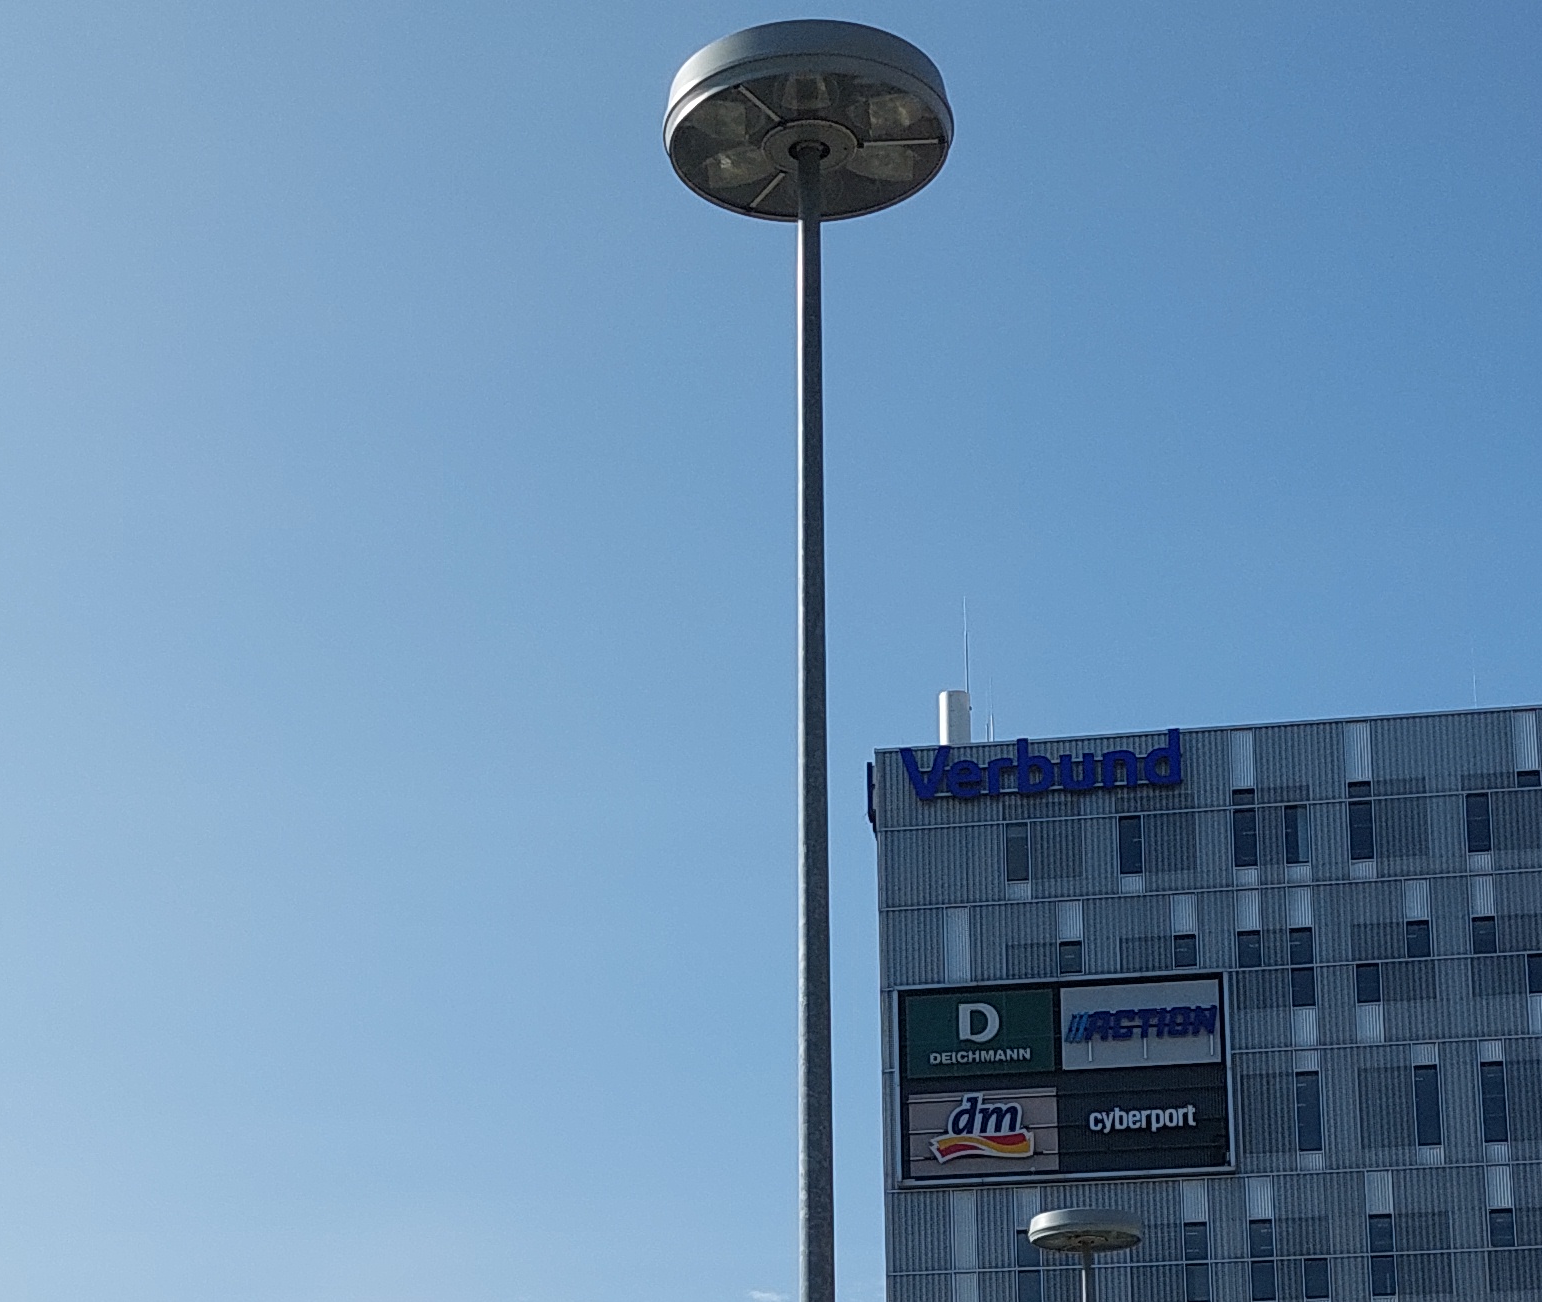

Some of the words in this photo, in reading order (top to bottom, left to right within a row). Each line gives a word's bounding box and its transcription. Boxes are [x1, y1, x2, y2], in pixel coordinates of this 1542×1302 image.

[900, 728, 1183, 800] Verbund
[958, 1002, 1000, 1043] D
[1084, 1004, 1218, 1041] ACTION
[929, 1048, 1031, 1065] DEICHMANN
[949, 1094, 1022, 1135] dm
[1089, 1104, 1197, 1133] cyberport
